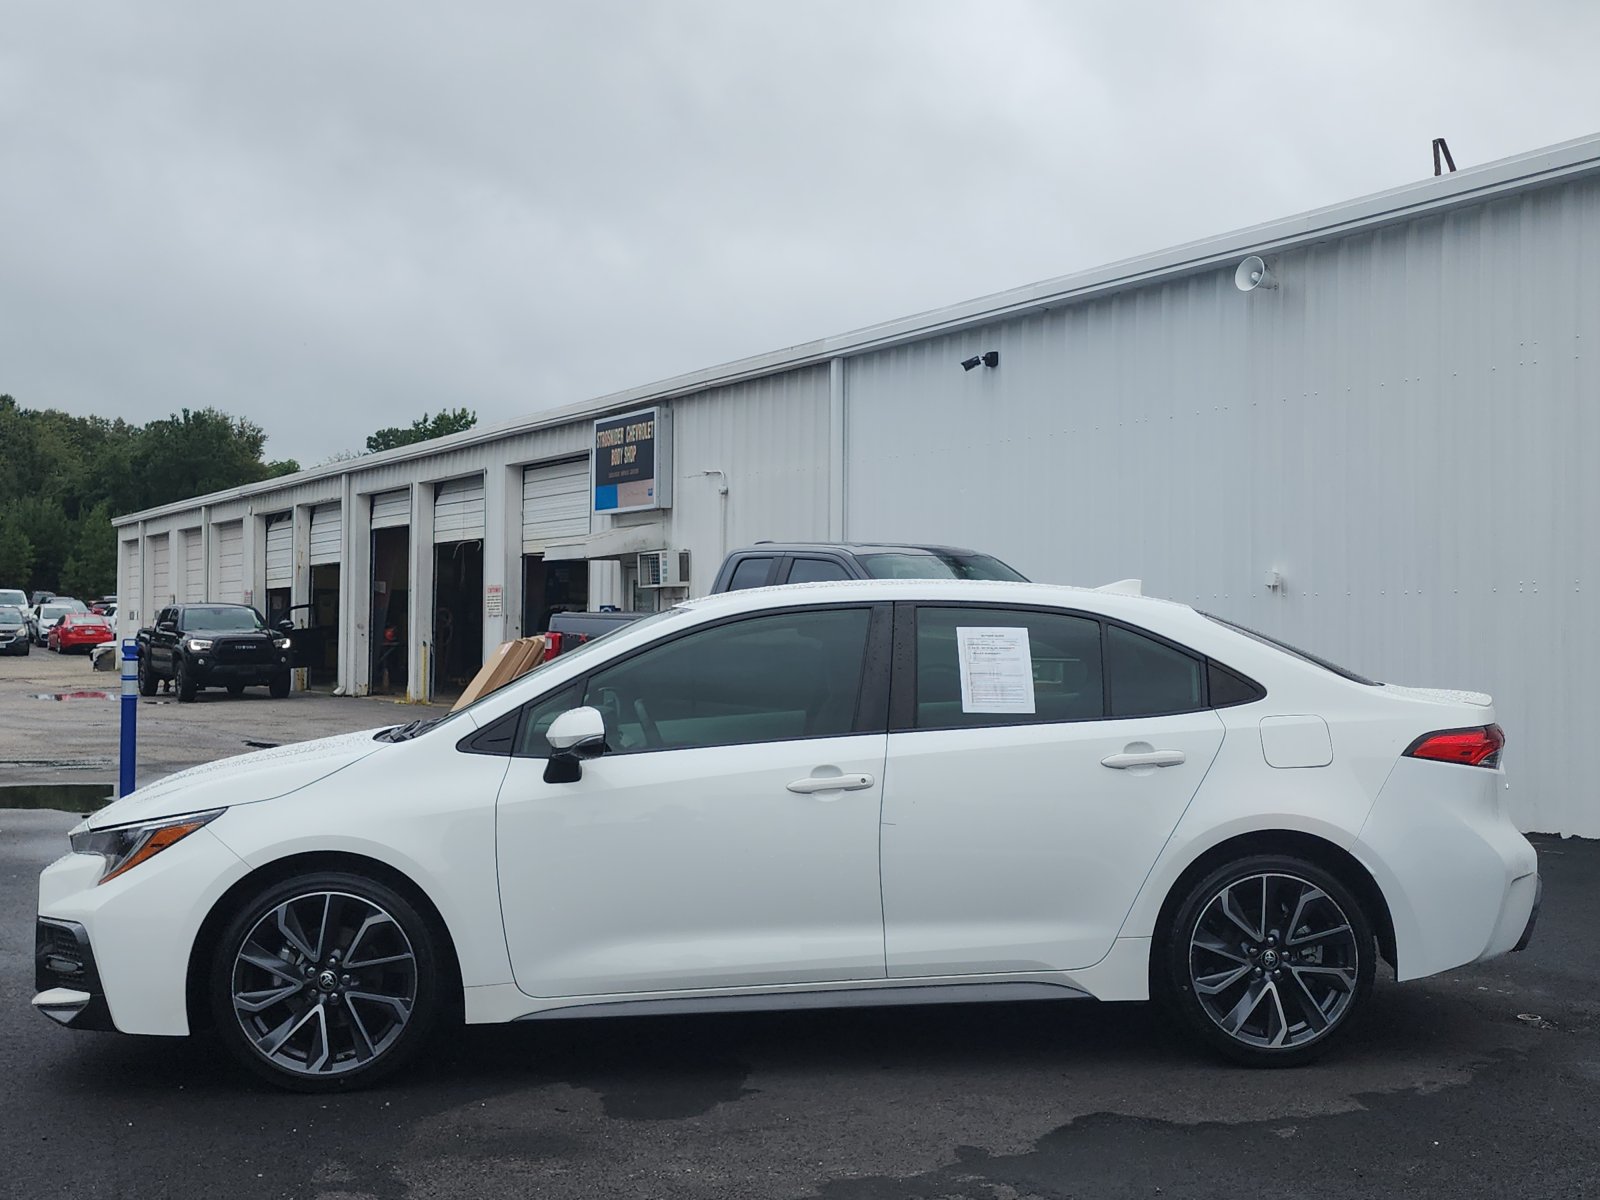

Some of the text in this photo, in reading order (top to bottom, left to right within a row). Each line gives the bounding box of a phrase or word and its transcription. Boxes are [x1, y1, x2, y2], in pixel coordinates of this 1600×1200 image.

[626, 421, 654, 443] CHEVROLET
[611, 446, 637, 466] BODY SHOP
